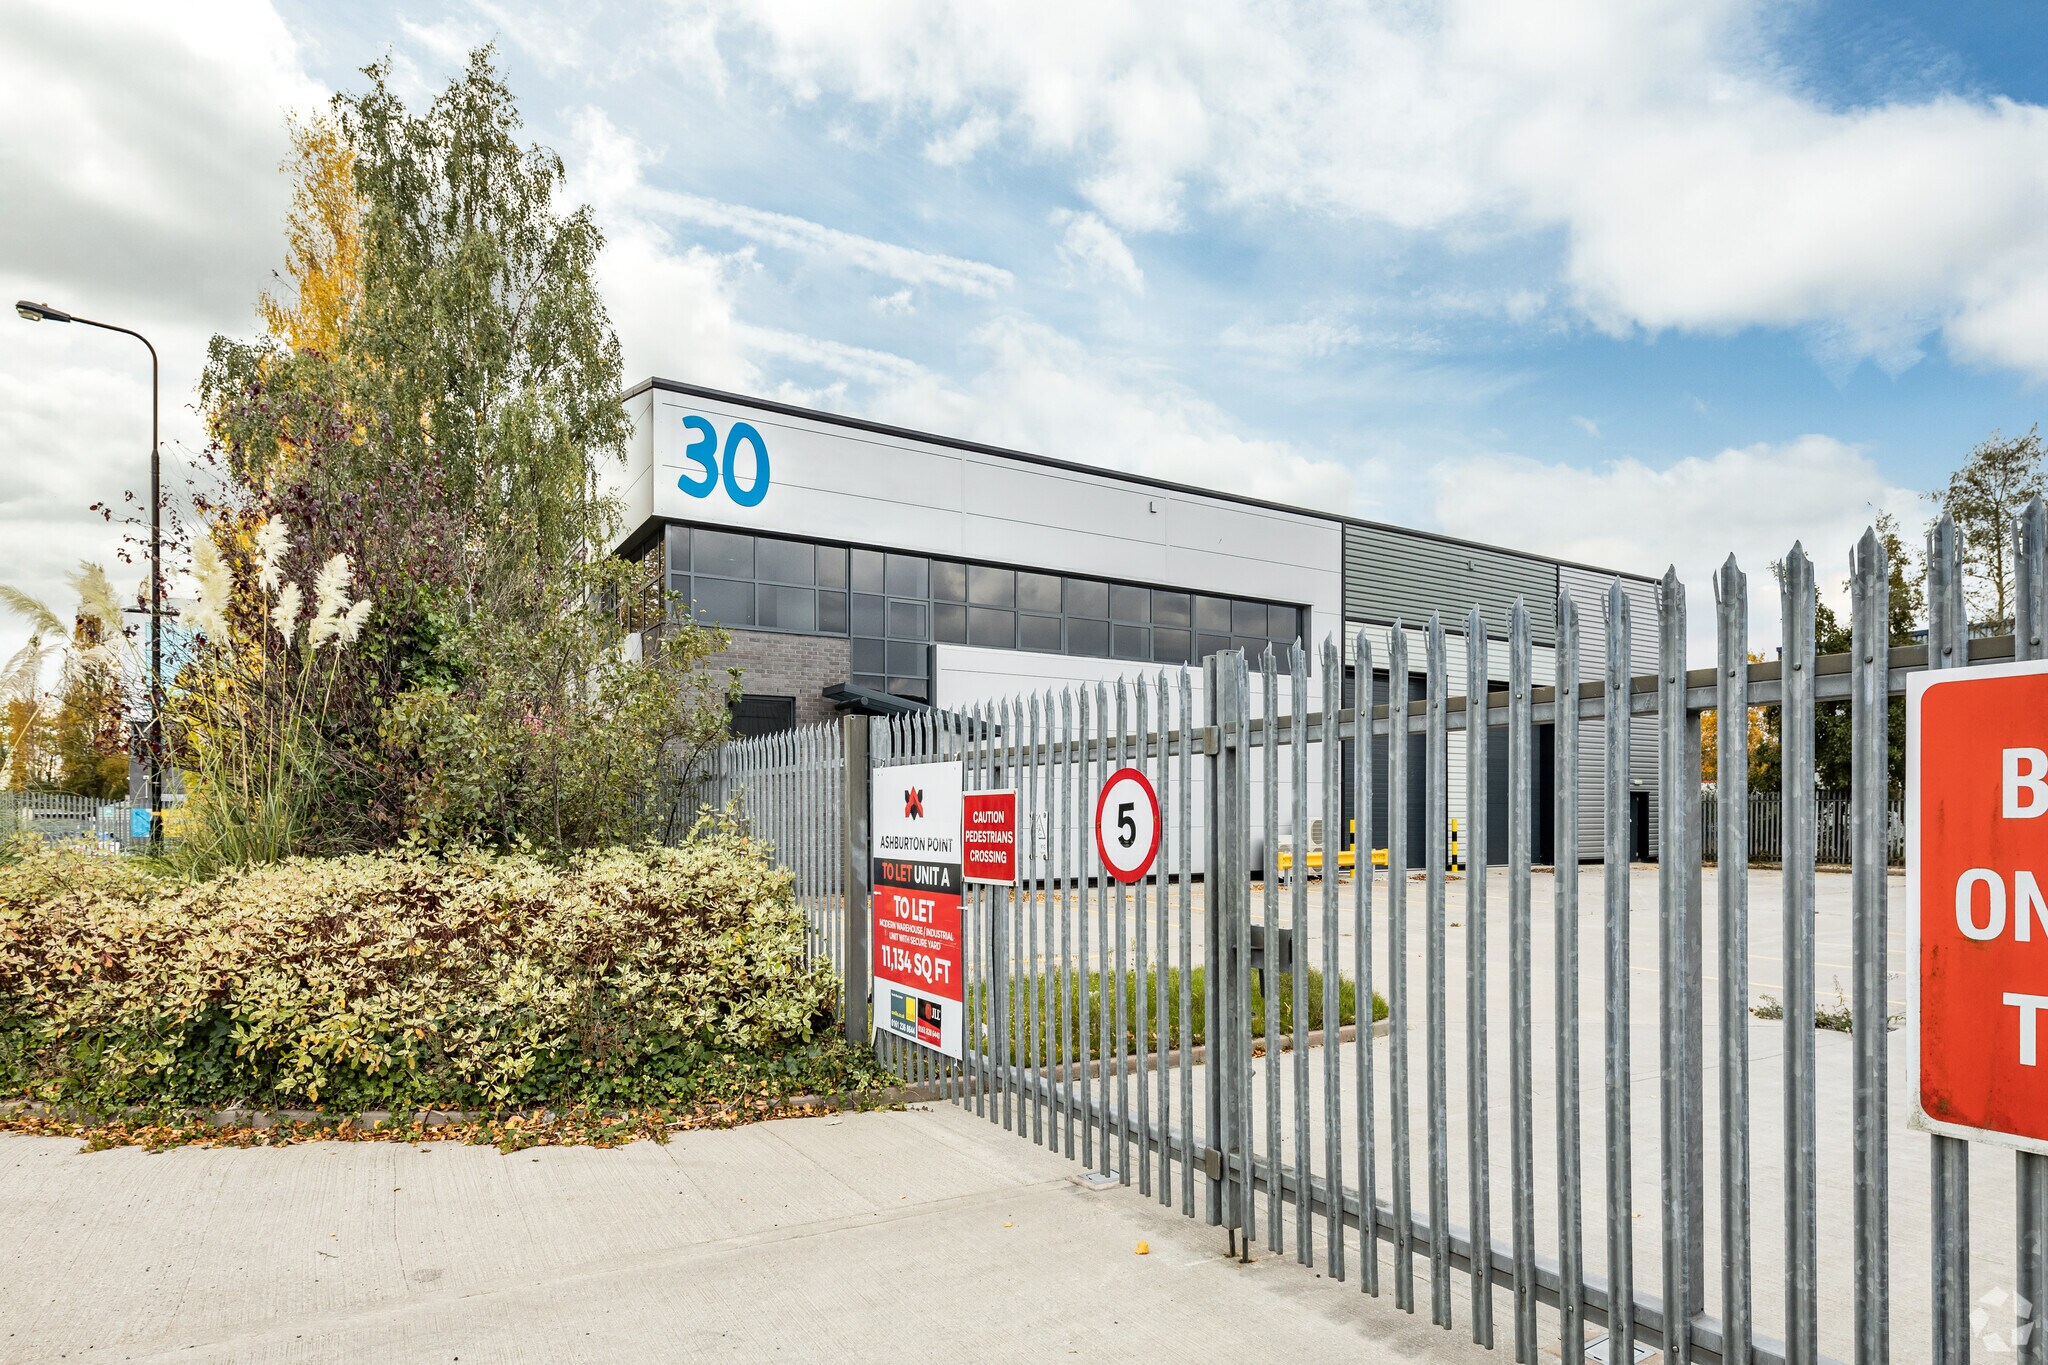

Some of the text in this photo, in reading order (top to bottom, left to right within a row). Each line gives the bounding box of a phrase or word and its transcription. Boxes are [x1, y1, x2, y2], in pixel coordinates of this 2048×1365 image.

[677, 415, 771, 507] 30
[972, 810, 1005, 824] CAUTION
[1117, 802, 1136, 849] 5
[880, 835, 952, 852] ASHBURTON POINT
[965, 830, 1013, 844] PEDESTRIANS
[969, 849, 1007, 864] CROSSING
[882, 862, 950, 887] TO LET UNIT A
[893, 895, 935, 924] TO LET
[879, 918, 897, 929] MODERN
[897, 922, 923, 935] WAREHOUSE
[926, 928, 954, 941] INDUSTRIAL
[910, 936, 928, 948] SECURE
[927, 940, 941, 951] YARD
[881, 944, 951, 984] 11,134 SQ FT
